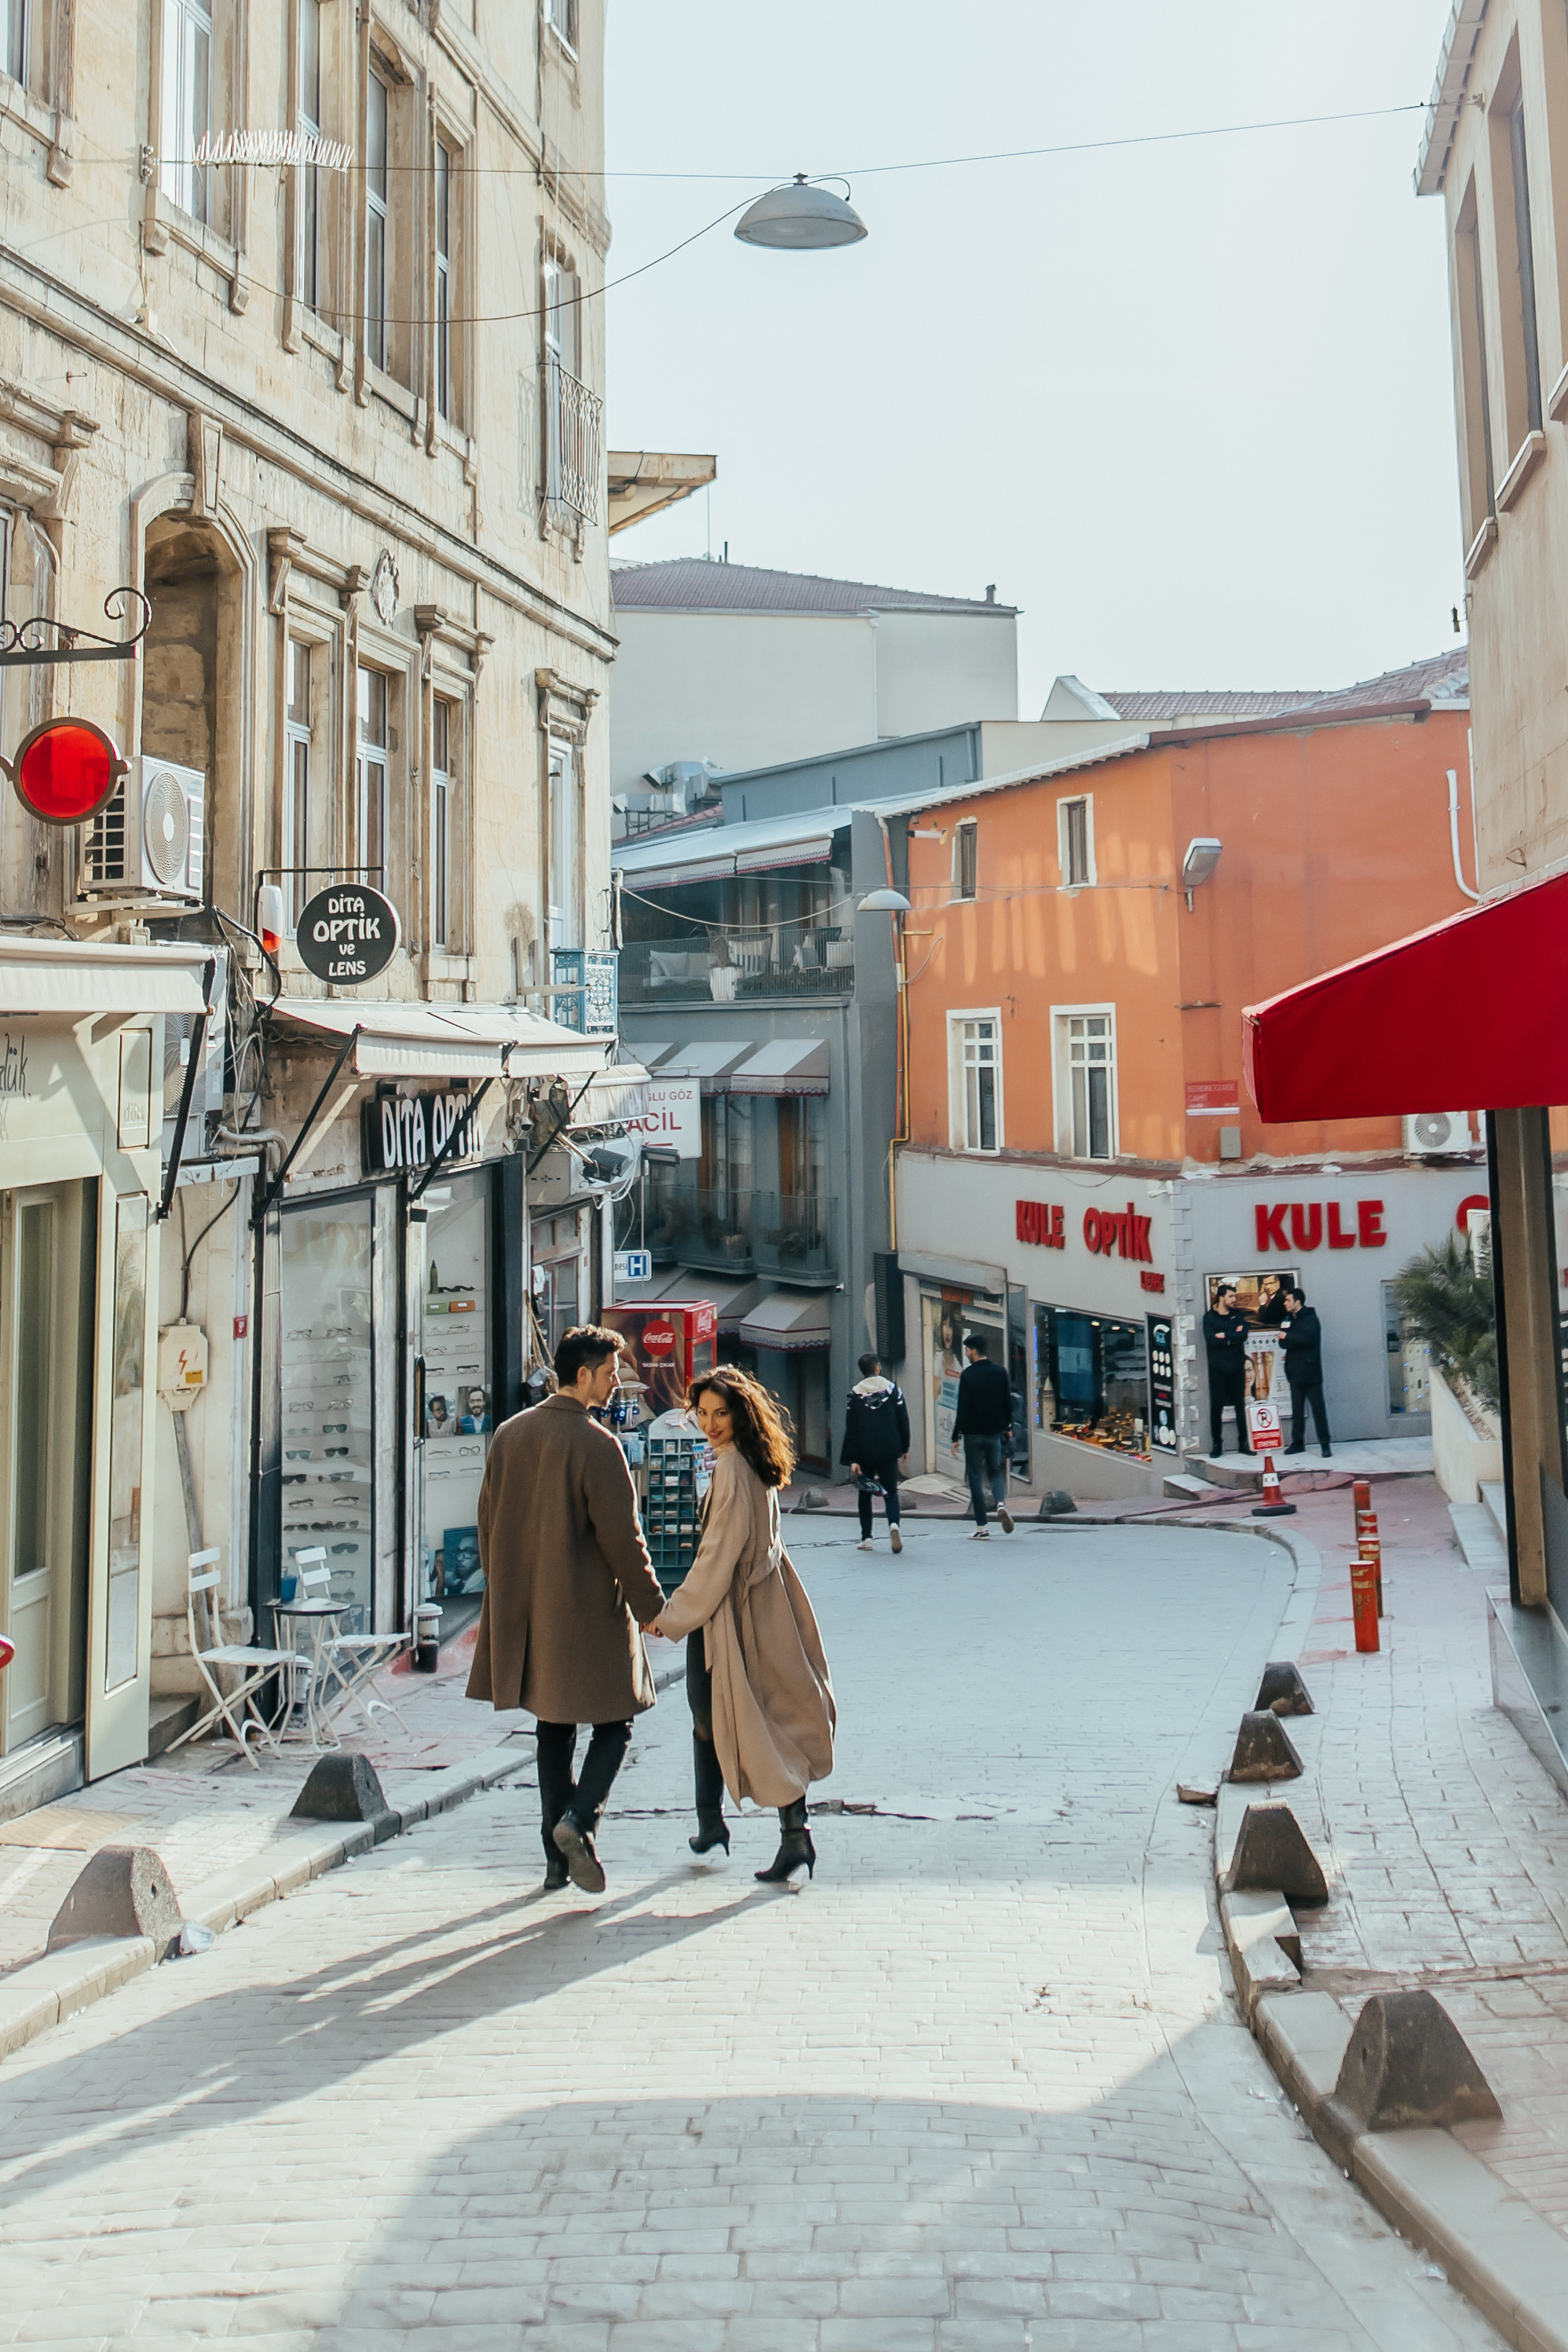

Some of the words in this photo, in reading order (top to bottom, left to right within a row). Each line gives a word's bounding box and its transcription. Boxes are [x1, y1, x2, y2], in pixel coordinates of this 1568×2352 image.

[328, 894, 364, 913] DİTA
[313, 913, 381, 942] OPTİK
[338, 944, 356, 955] ve
[328, 960, 367, 976] LENS
[669, 1088, 693, 1100] GÖZ
[627, 1107, 682, 1133] ACİL
[1016, 1200, 1065, 1249] KULE
[1084, 1202, 1153, 1264] OPTİK
[1255, 1200, 1387, 1251] KULE
